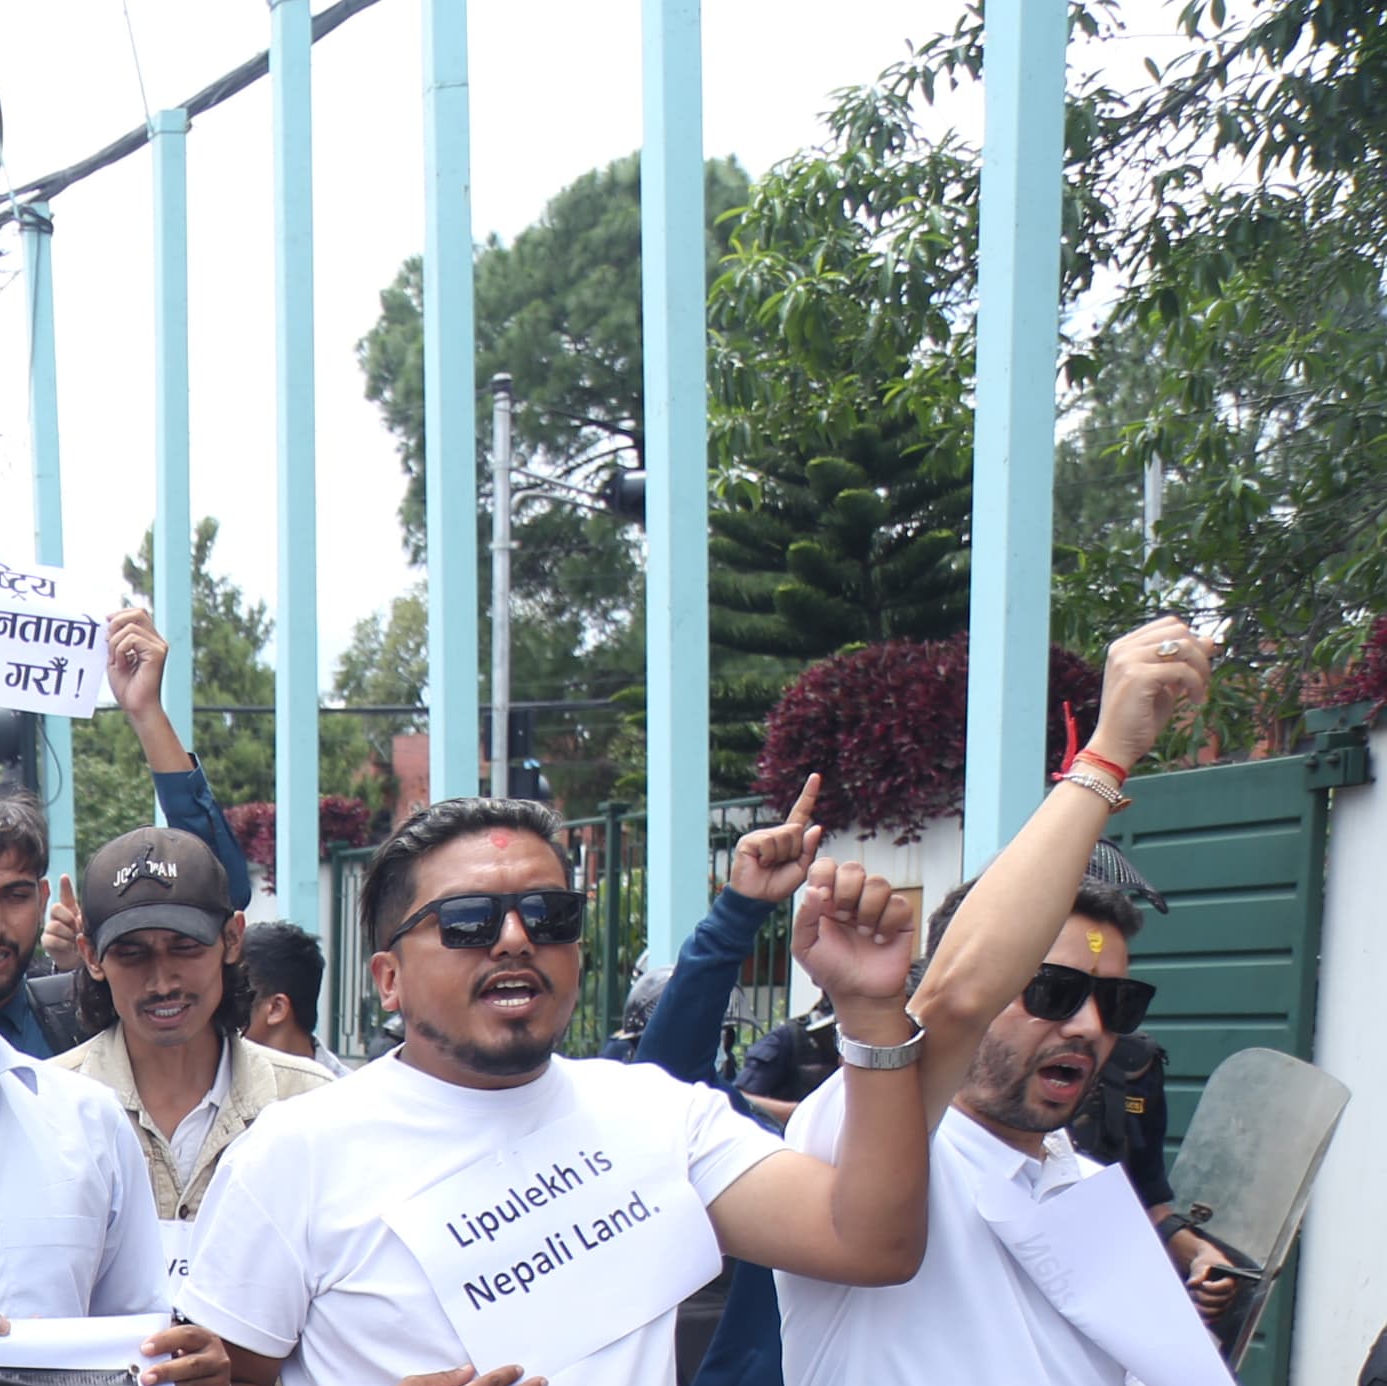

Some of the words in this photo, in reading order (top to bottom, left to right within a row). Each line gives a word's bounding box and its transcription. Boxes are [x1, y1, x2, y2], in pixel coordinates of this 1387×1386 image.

[74, 668, 84, 699] !
[446, 1163, 584, 1248] Lipulekh
[578, 1150, 613, 1177] is
[462, 1233, 574, 1311] Nepali
[572, 1190, 661, 1251] Land.
